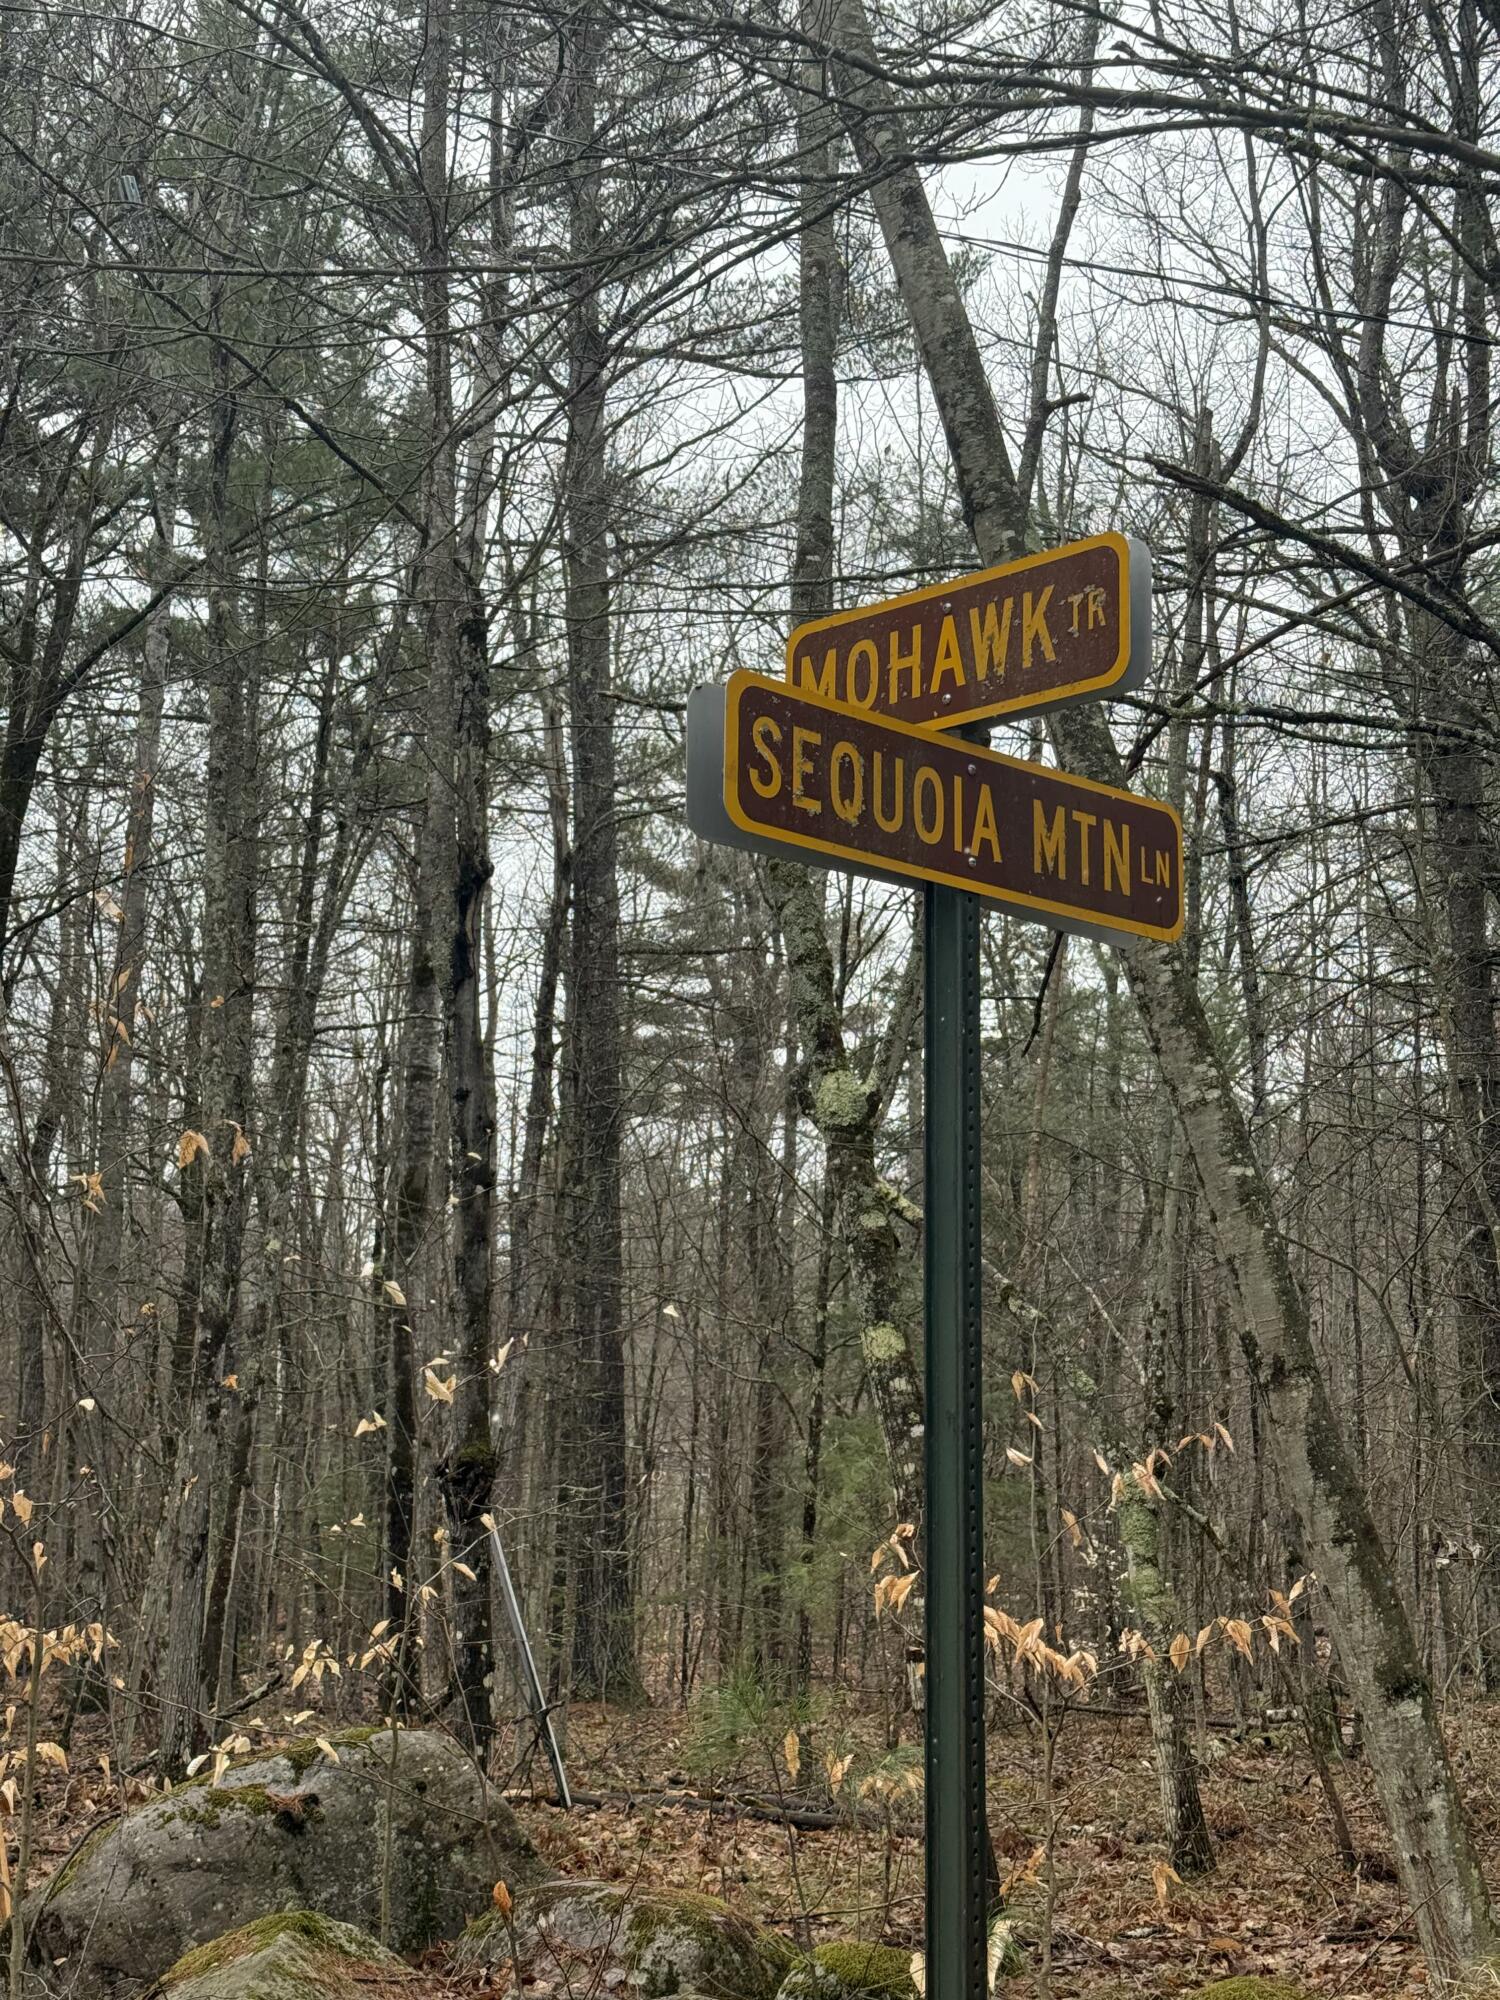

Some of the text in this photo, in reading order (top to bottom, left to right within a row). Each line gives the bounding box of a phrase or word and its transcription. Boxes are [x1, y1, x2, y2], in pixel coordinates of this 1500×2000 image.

[800, 584, 1107, 710] MOHAWK TR
[748, 716, 1171, 896] SEQUOIA MTN LN
